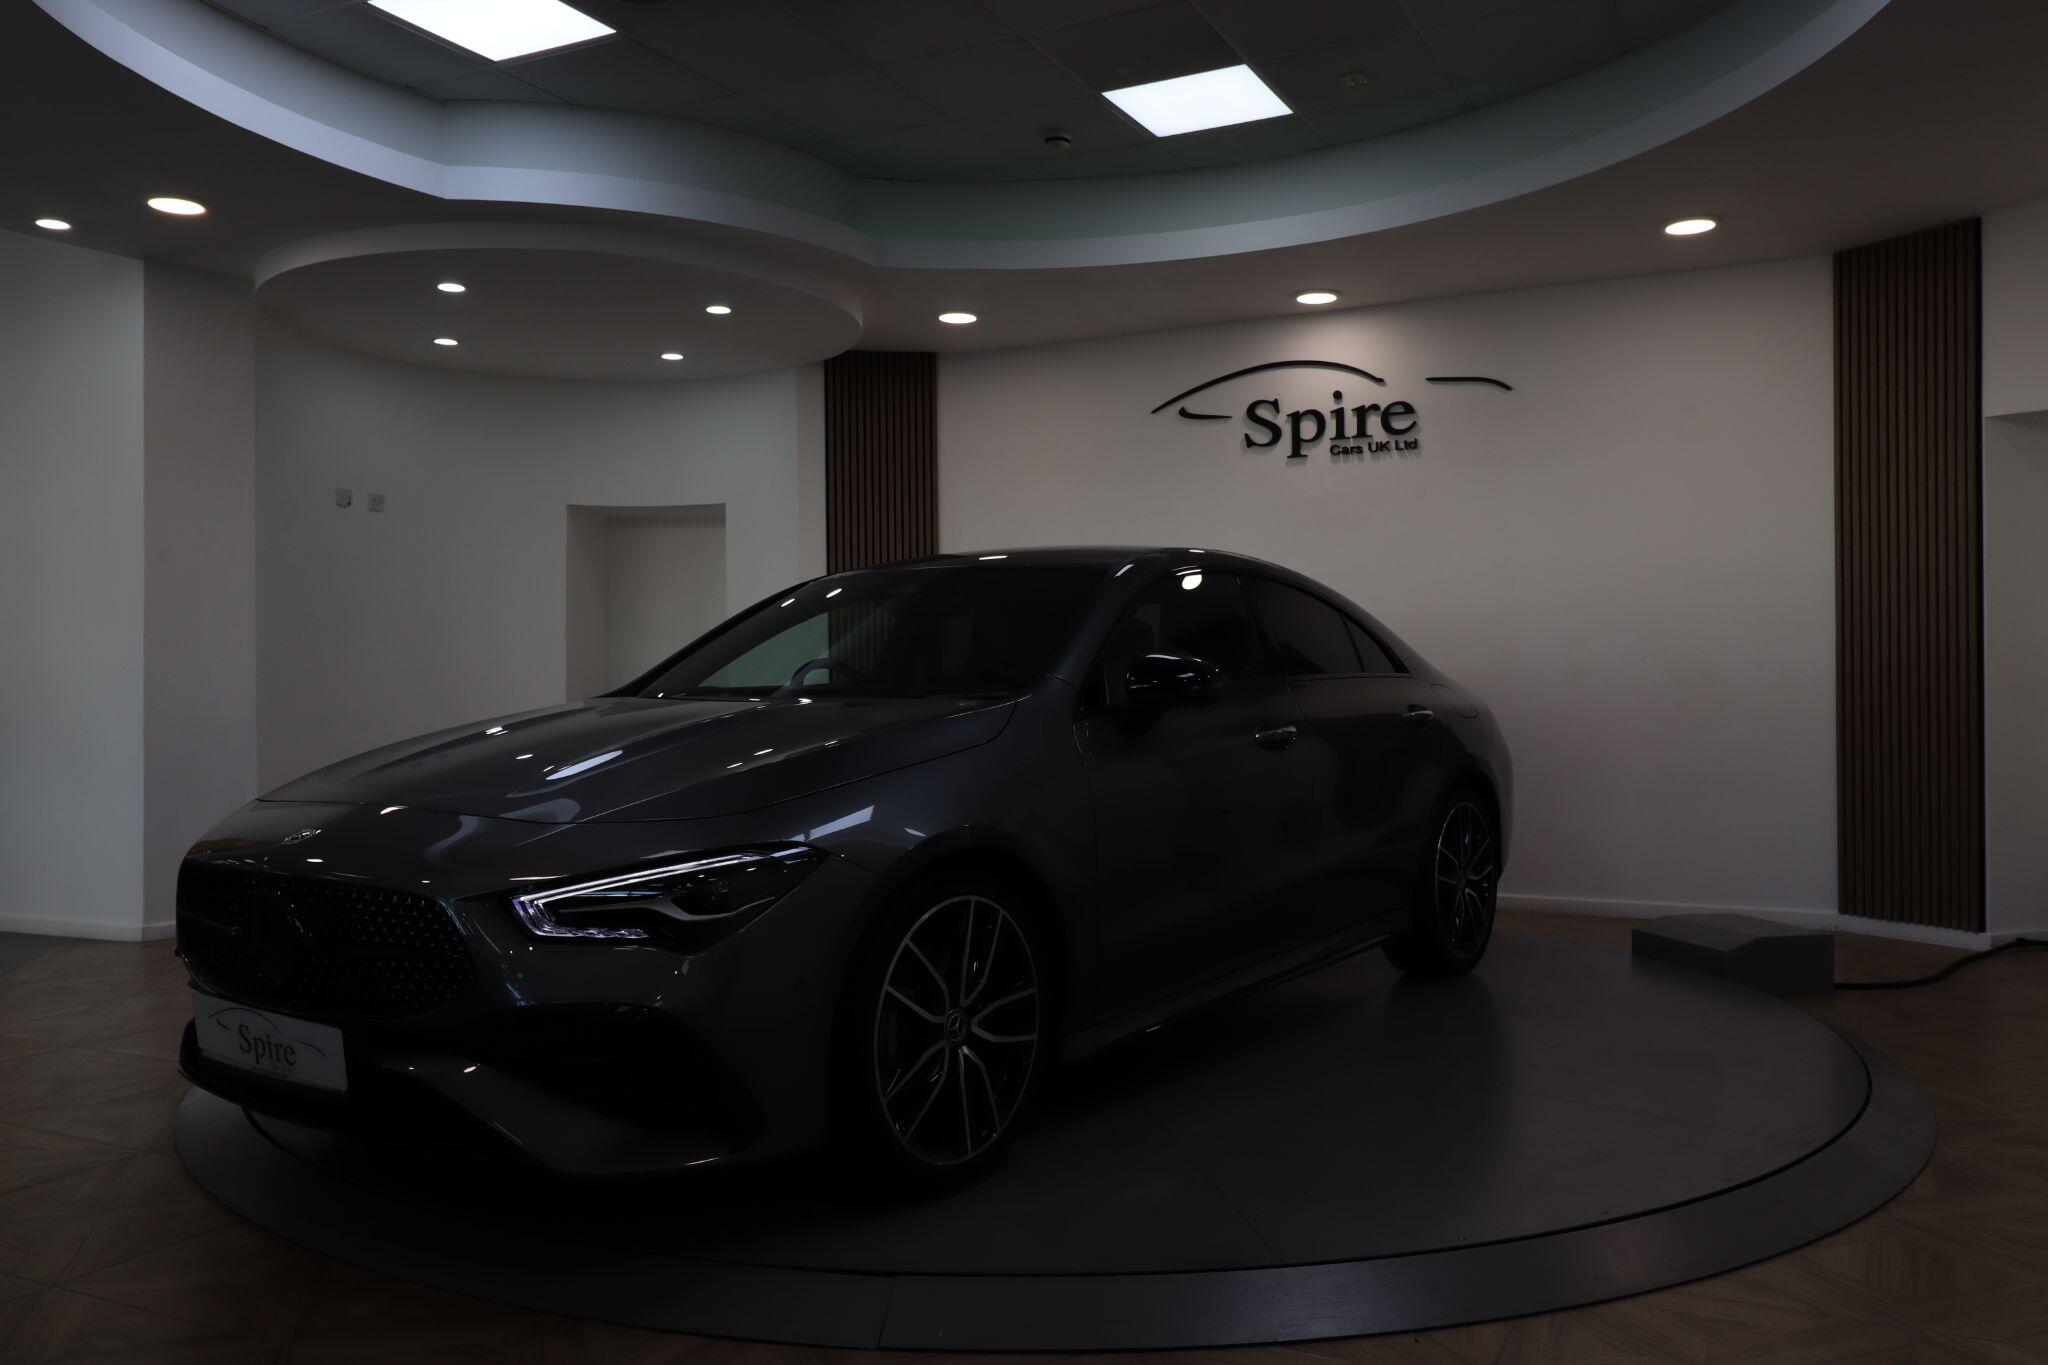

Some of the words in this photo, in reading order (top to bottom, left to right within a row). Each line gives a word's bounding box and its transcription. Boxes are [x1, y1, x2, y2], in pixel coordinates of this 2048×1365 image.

[1245, 391, 1416, 458] Spire
[1329, 444, 1363, 456] Cars
[1368, 440, 1391, 452] UK
[1394, 438, 1418, 451] Ltd
[238, 1024, 297, 1066] Spire
